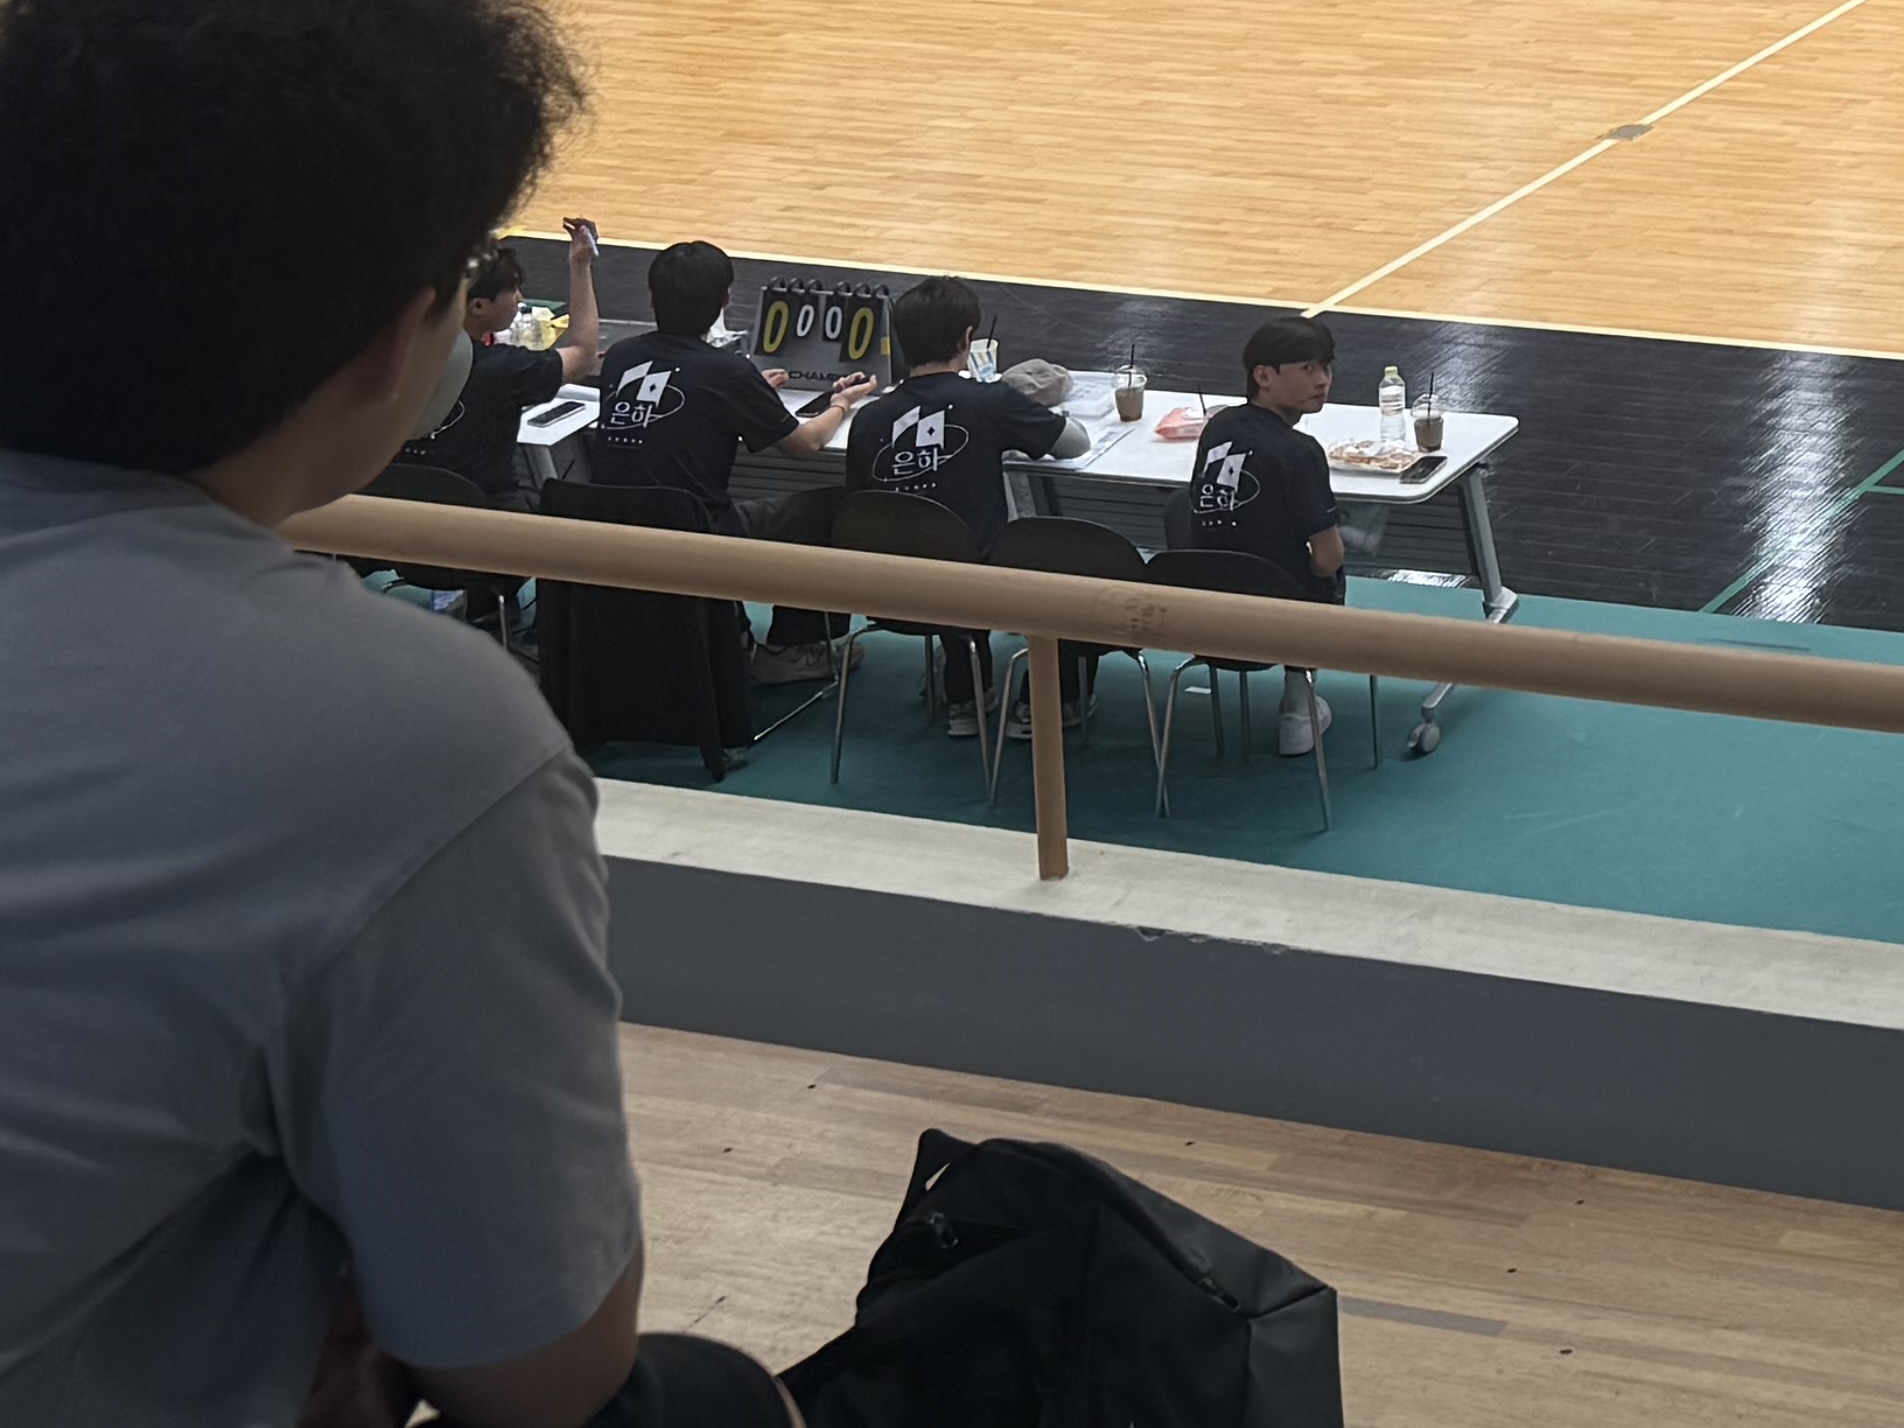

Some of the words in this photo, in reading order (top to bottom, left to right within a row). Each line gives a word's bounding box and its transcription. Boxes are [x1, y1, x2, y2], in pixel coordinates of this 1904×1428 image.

[763, 300, 790, 353] 0
[796, 304, 815, 337] 0
[825, 306, 843, 339] 0
[848, 307, 875, 360] 0
[610, 401, 655, 428] 은하
[892, 447, 938, 475] 은하
